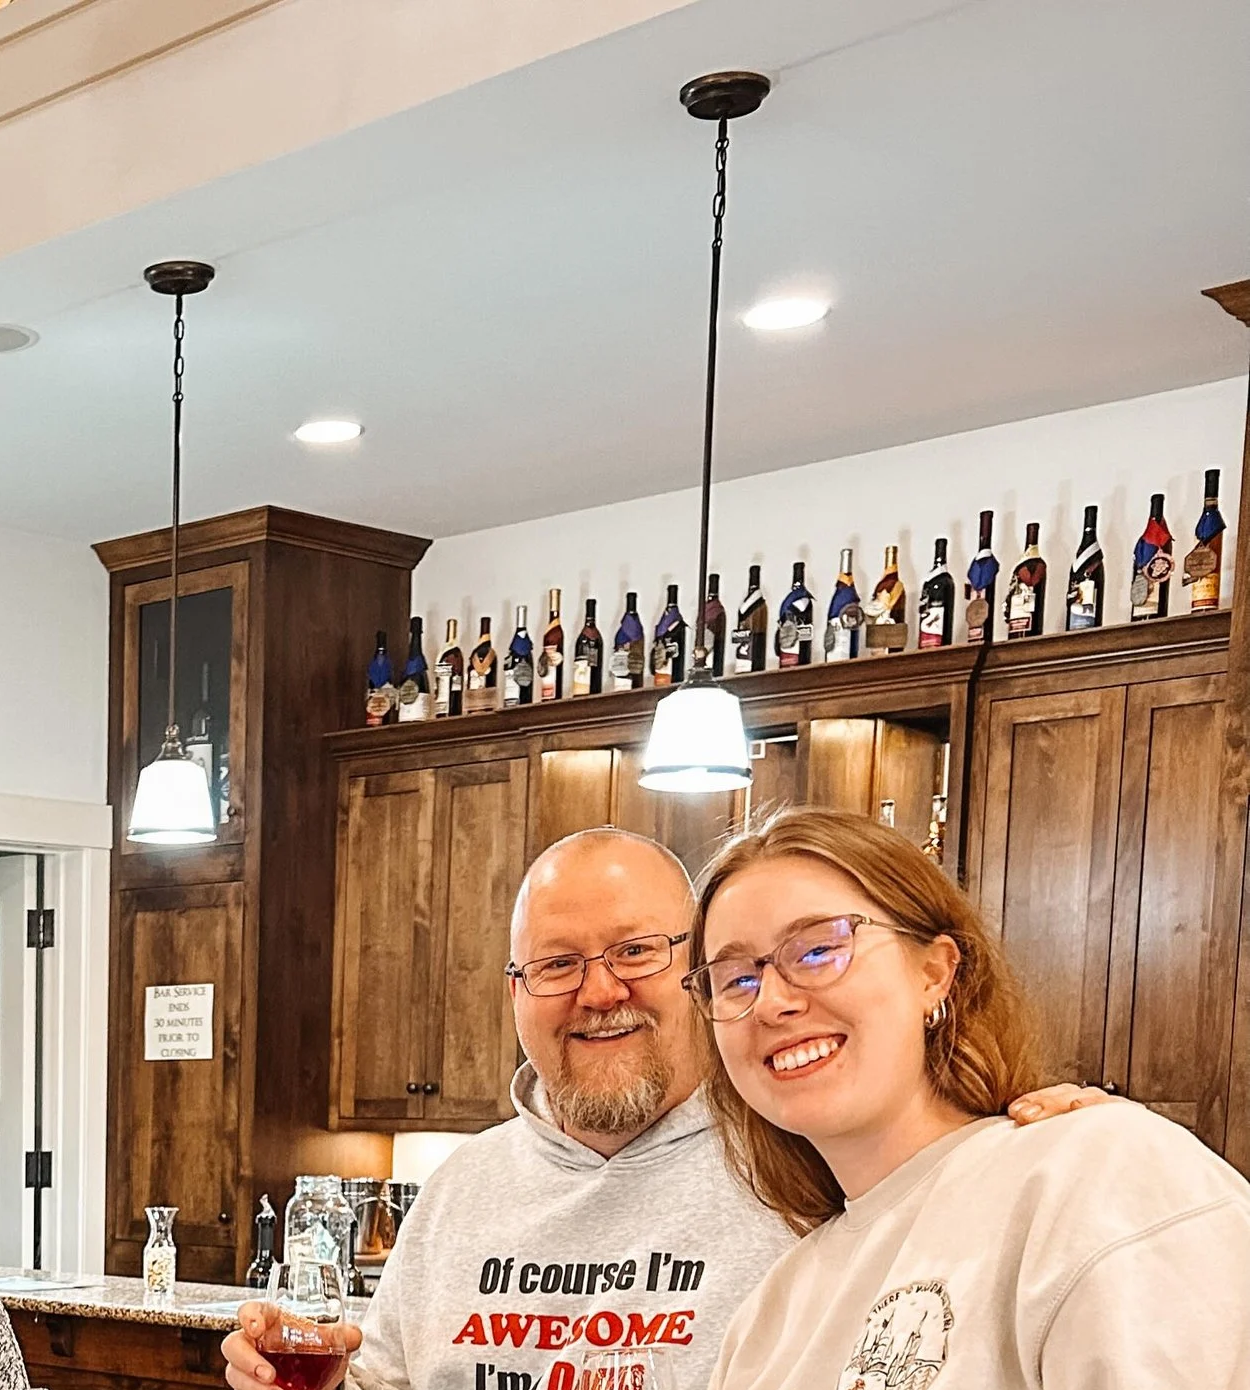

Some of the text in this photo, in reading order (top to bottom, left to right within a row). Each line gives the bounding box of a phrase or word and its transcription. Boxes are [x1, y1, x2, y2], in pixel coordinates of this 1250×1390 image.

[166, 1017, 204, 1027] MINUTES
[186, 1032, 200, 1042] TO
[160, 1047, 197, 1058] CLOSING
[479, 1252, 706, 1295] Of course I'm
[452, 1310, 695, 1350] AWESOME
